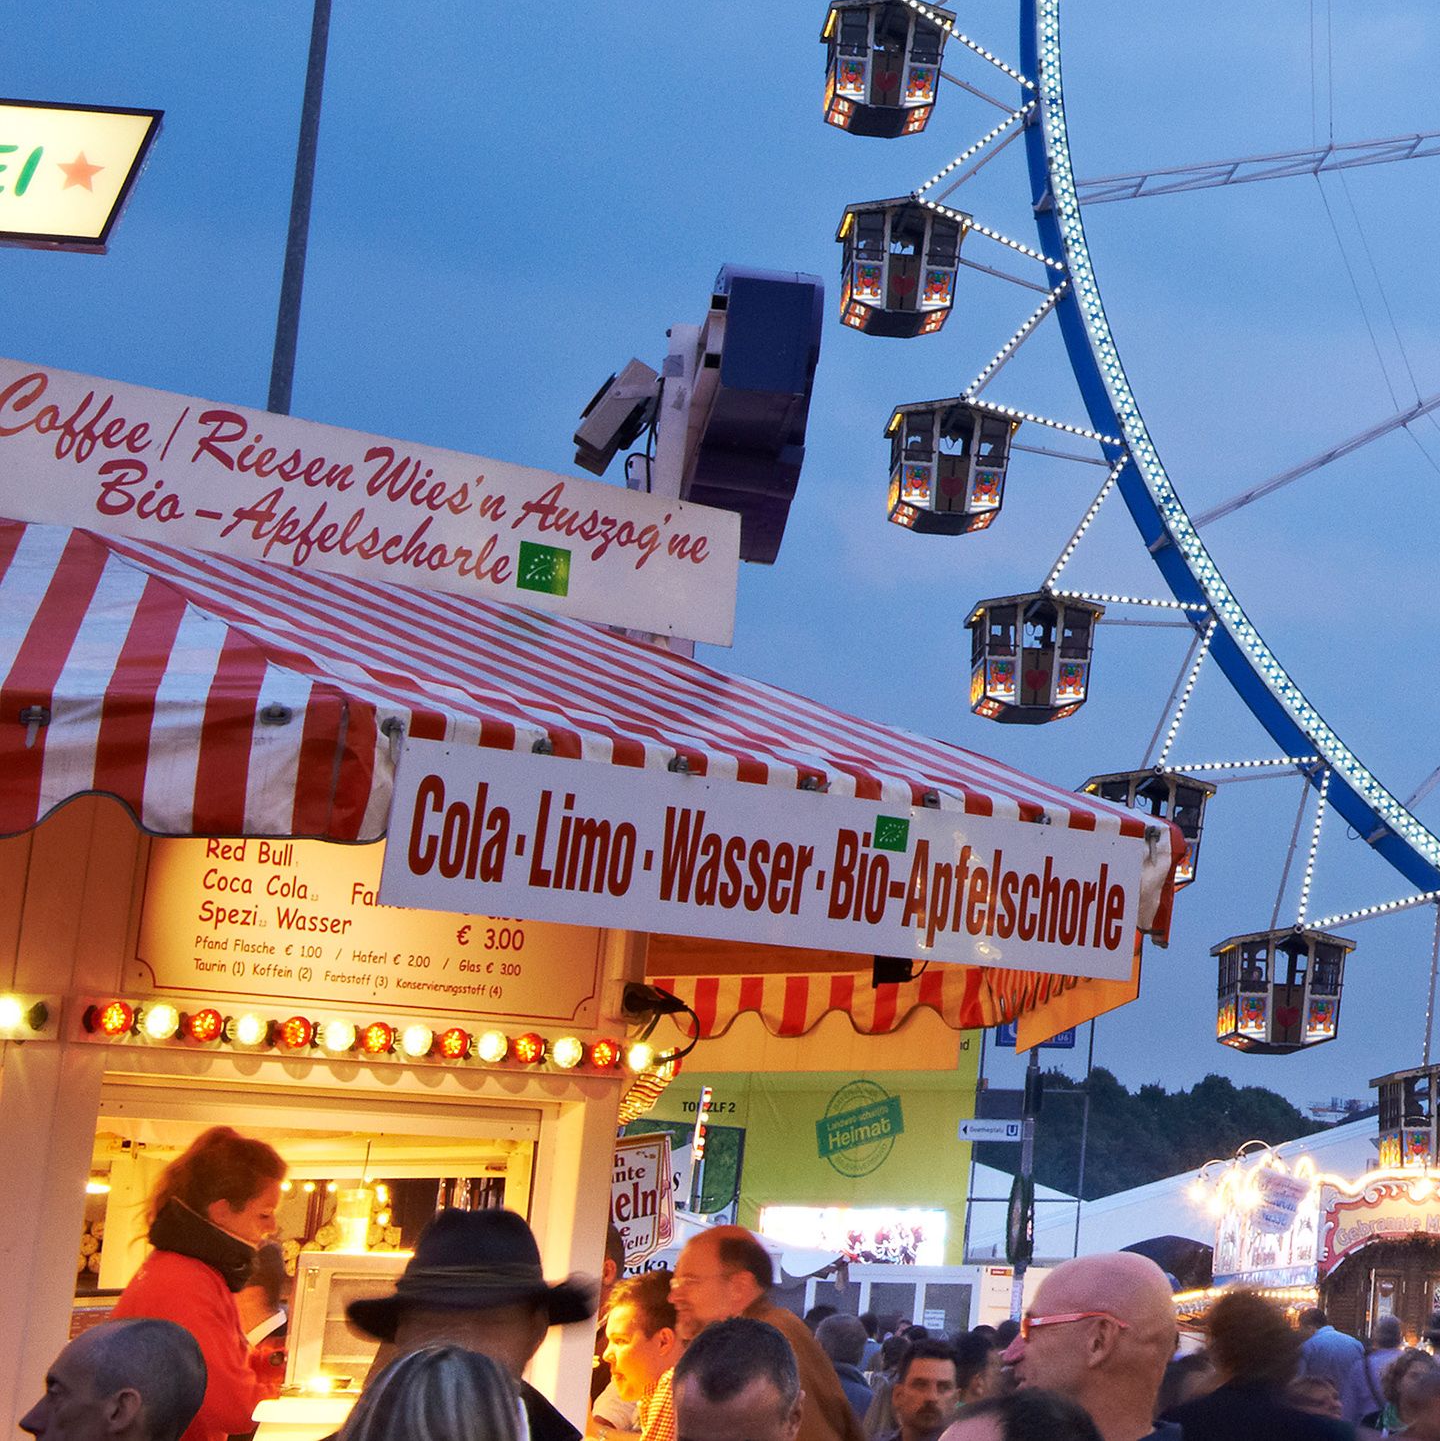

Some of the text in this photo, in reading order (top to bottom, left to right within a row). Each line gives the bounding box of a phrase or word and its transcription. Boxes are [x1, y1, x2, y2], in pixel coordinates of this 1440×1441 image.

[0, 372, 152, 461] Coffee
[192, 410, 354, 492] Riesen
[364, 446, 506, 521] Wies'n
[512, 481, 711, 569] Auszog'ne
[206, 839, 294, 866] Red Bull
[203, 869, 308, 900] Coca Cola
[198, 900, 525, 951] Spezi Wasser € 3.00
[195, 936, 228, 951] Pfand
[234, 939, 276, 955] Flasche
[285, 944, 293, 956] €
[301, 946, 322, 959] 1.00
[352, 949, 387, 965] Haferl
[393, 954, 401, 966] €
[408, 954, 430, 968] 2.00
[459, 959, 481, 973] Glas
[486, 962, 494, 973] €
[500, 963, 522, 976] 3.00
[194, 958, 502, 998] Taurin (1) Koffein (2) Farbstoff (3) Konservierungsstoff (4)
[729, 1103, 736, 1113] 2
[828, 1117, 891, 1150] Heimat
[1335, 1214, 1422, 1246] Gebrannte
